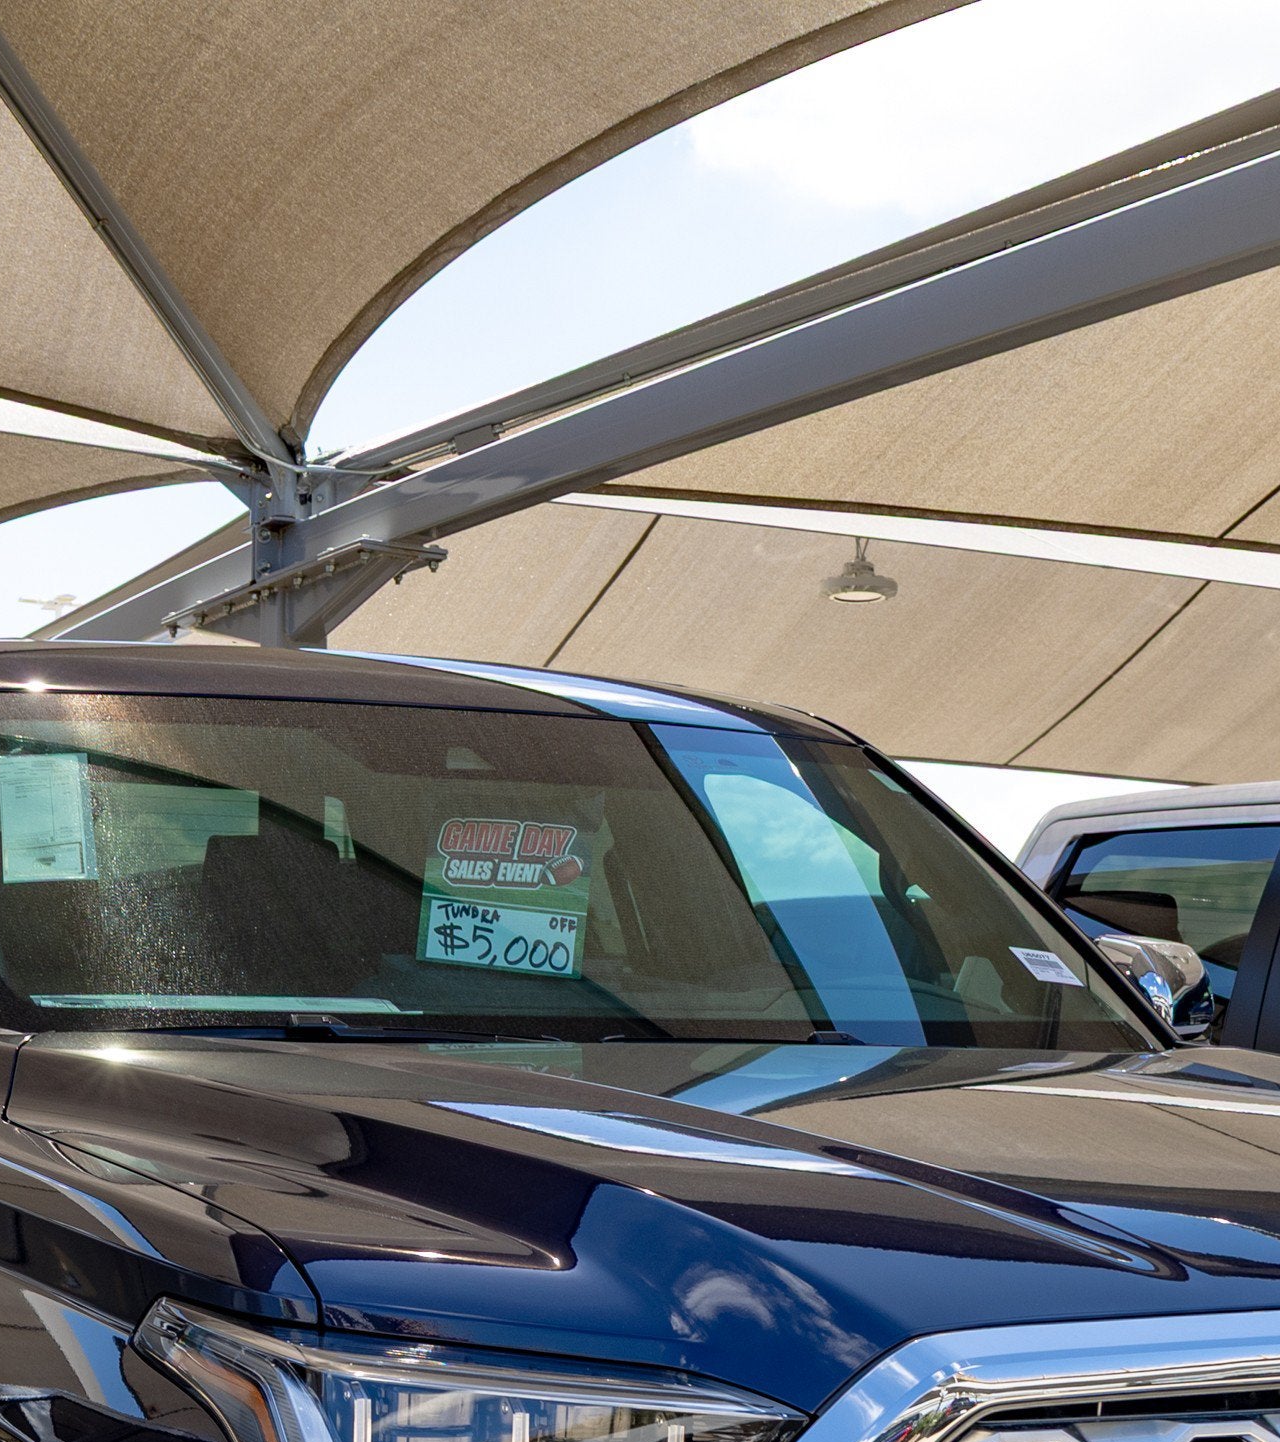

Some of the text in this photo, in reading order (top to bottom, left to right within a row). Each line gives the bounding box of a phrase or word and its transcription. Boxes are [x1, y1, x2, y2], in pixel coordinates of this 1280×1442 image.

[441, 822, 574, 858] GAME DAY
[447, 859, 543, 883] SALES EVENT
[437, 903, 577, 932] TUNDRA OFF
[434, 922, 570, 972] $5,000
